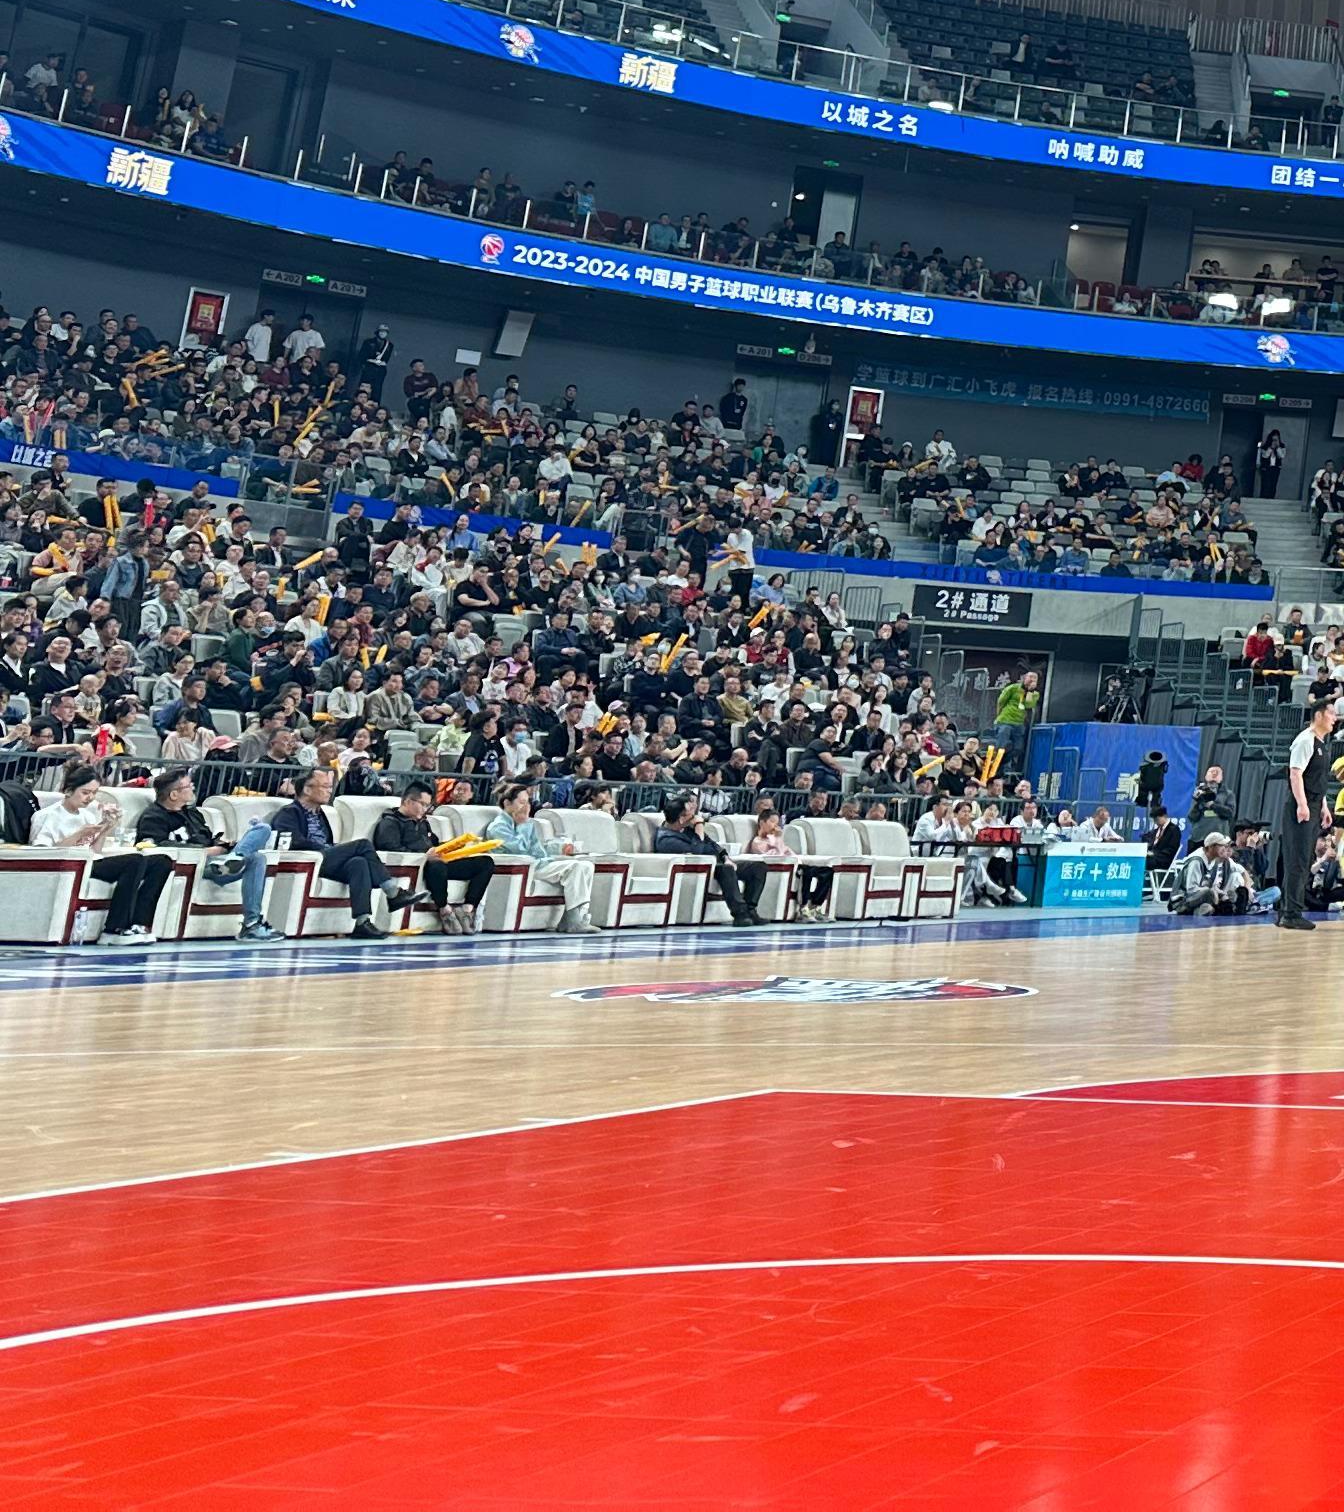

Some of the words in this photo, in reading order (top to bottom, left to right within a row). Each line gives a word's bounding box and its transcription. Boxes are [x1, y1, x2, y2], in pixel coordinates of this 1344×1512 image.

[619, 51, 678, 93] 新疆
[822, 100, 917, 136] 以城之名
[107, 147, 176, 195] 新疆
[1048, 137, 1145, 169] 呐喊助威
[512, 244, 630, 282] 2023-2024
[856, 364, 1016, 397] 学篮球到广汇小飞虎
[969, 592, 1010, 614] 通道
